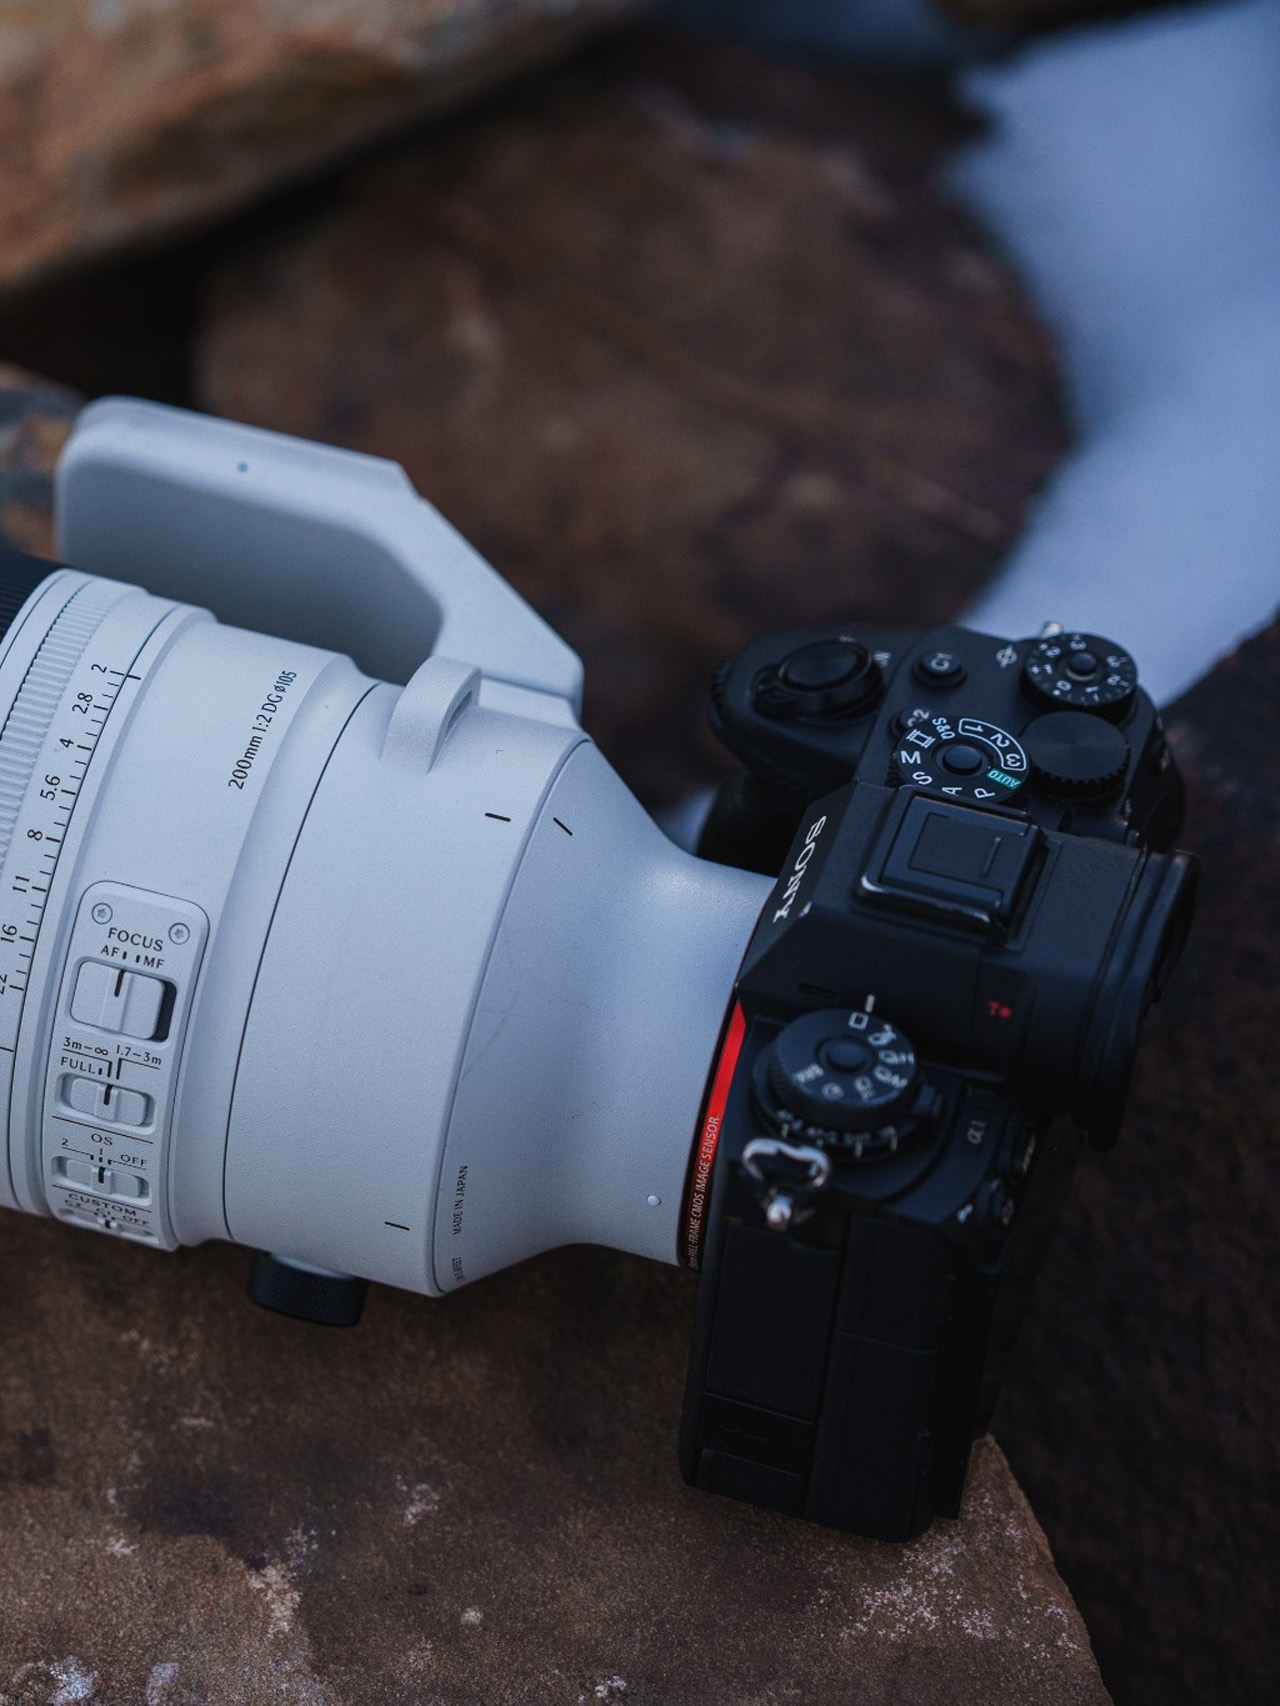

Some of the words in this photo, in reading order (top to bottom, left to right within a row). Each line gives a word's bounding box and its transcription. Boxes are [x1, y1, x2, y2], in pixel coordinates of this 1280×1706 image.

[91, 663, 107, 674] 2
[72, 693, 94, 714] 2.8
[261, 693, 283, 713] DG
[252, 714, 273, 732] 1:2
[931, 717, 956, 740] S&Q
[964, 724, 984, 733] 1
[59, 738, 74, 749] 4
[990, 733, 1010, 748] 2
[228, 735, 263, 790] 200mm
[900, 750, 921, 764] M
[1006, 753, 1021, 767] 3
[912, 771, 933, 785] S
[988, 770, 1021, 788] AUTO
[40, 775, 61, 801] 5.6
[941, 786, 962, 796] A
[974, 787, 996, 799] P
[27, 829, 43, 841] 8
[773, 815, 827, 923] SONY
[12, 874, 30, 893] 11
[0, 924, 18, 944] 16
[108, 927, 164, 952] FOCUS
[100, 944, 120, 957] AF
[142, 955, 165, 969] MF
[60, 1056, 96, 1074] FULL
[91, 1133, 113, 1146] OS
[705, 1116, 720, 1160] SENSOR
[61, 1138, 69, 1146] 2
[120, 1154, 148, 1166] OFF
[455, 1165, 468, 1197] JAPAN
[696, 1161, 710, 1192] IMAGE
[68, 1193, 136, 1216] CUSTOM
[454, 1199, 464, 1211] IN
[695, 1193, 705, 1218] CMOS
[452, 1212, 464, 1236] MADE
